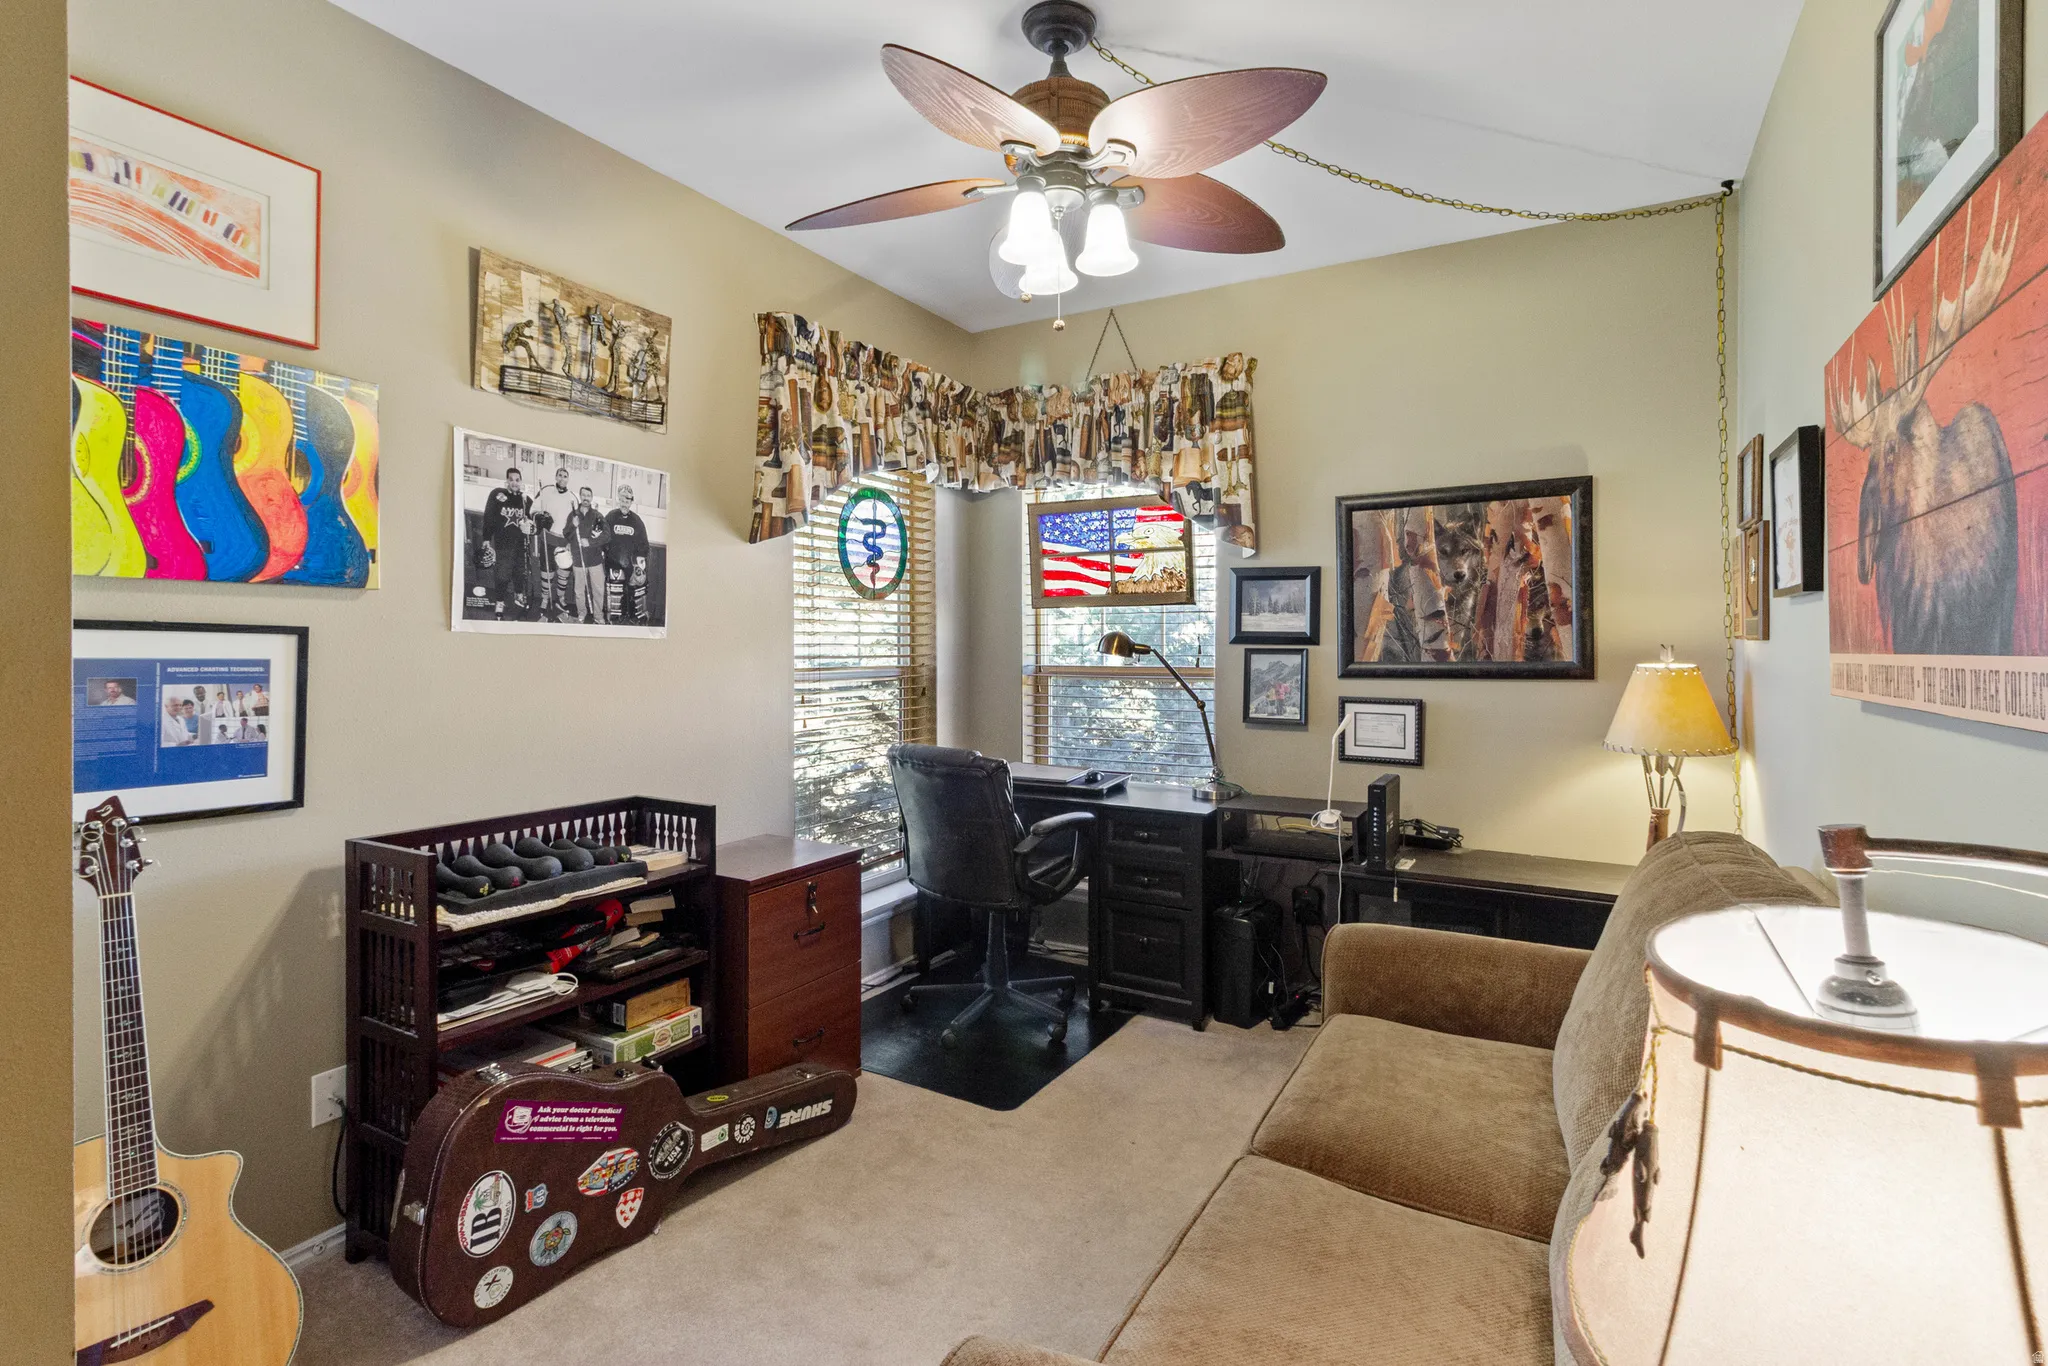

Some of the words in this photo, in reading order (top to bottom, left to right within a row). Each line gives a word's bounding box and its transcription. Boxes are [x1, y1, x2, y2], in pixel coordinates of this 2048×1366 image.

[1922, 666, 1937, 704] THE
[1939, 667, 1966, 709] GRAND
[1969, 669, 2001, 714] IMAGE
[569, 1106, 591, 1114] doctor
[780, 1099, 833, 1128] SHURE
[667, 1146, 681, 1162] USA
[580, 1158, 638, 1188] PEACE
[536, 1189, 545, 1203] 66
[470, 1207, 502, 1250] IB
